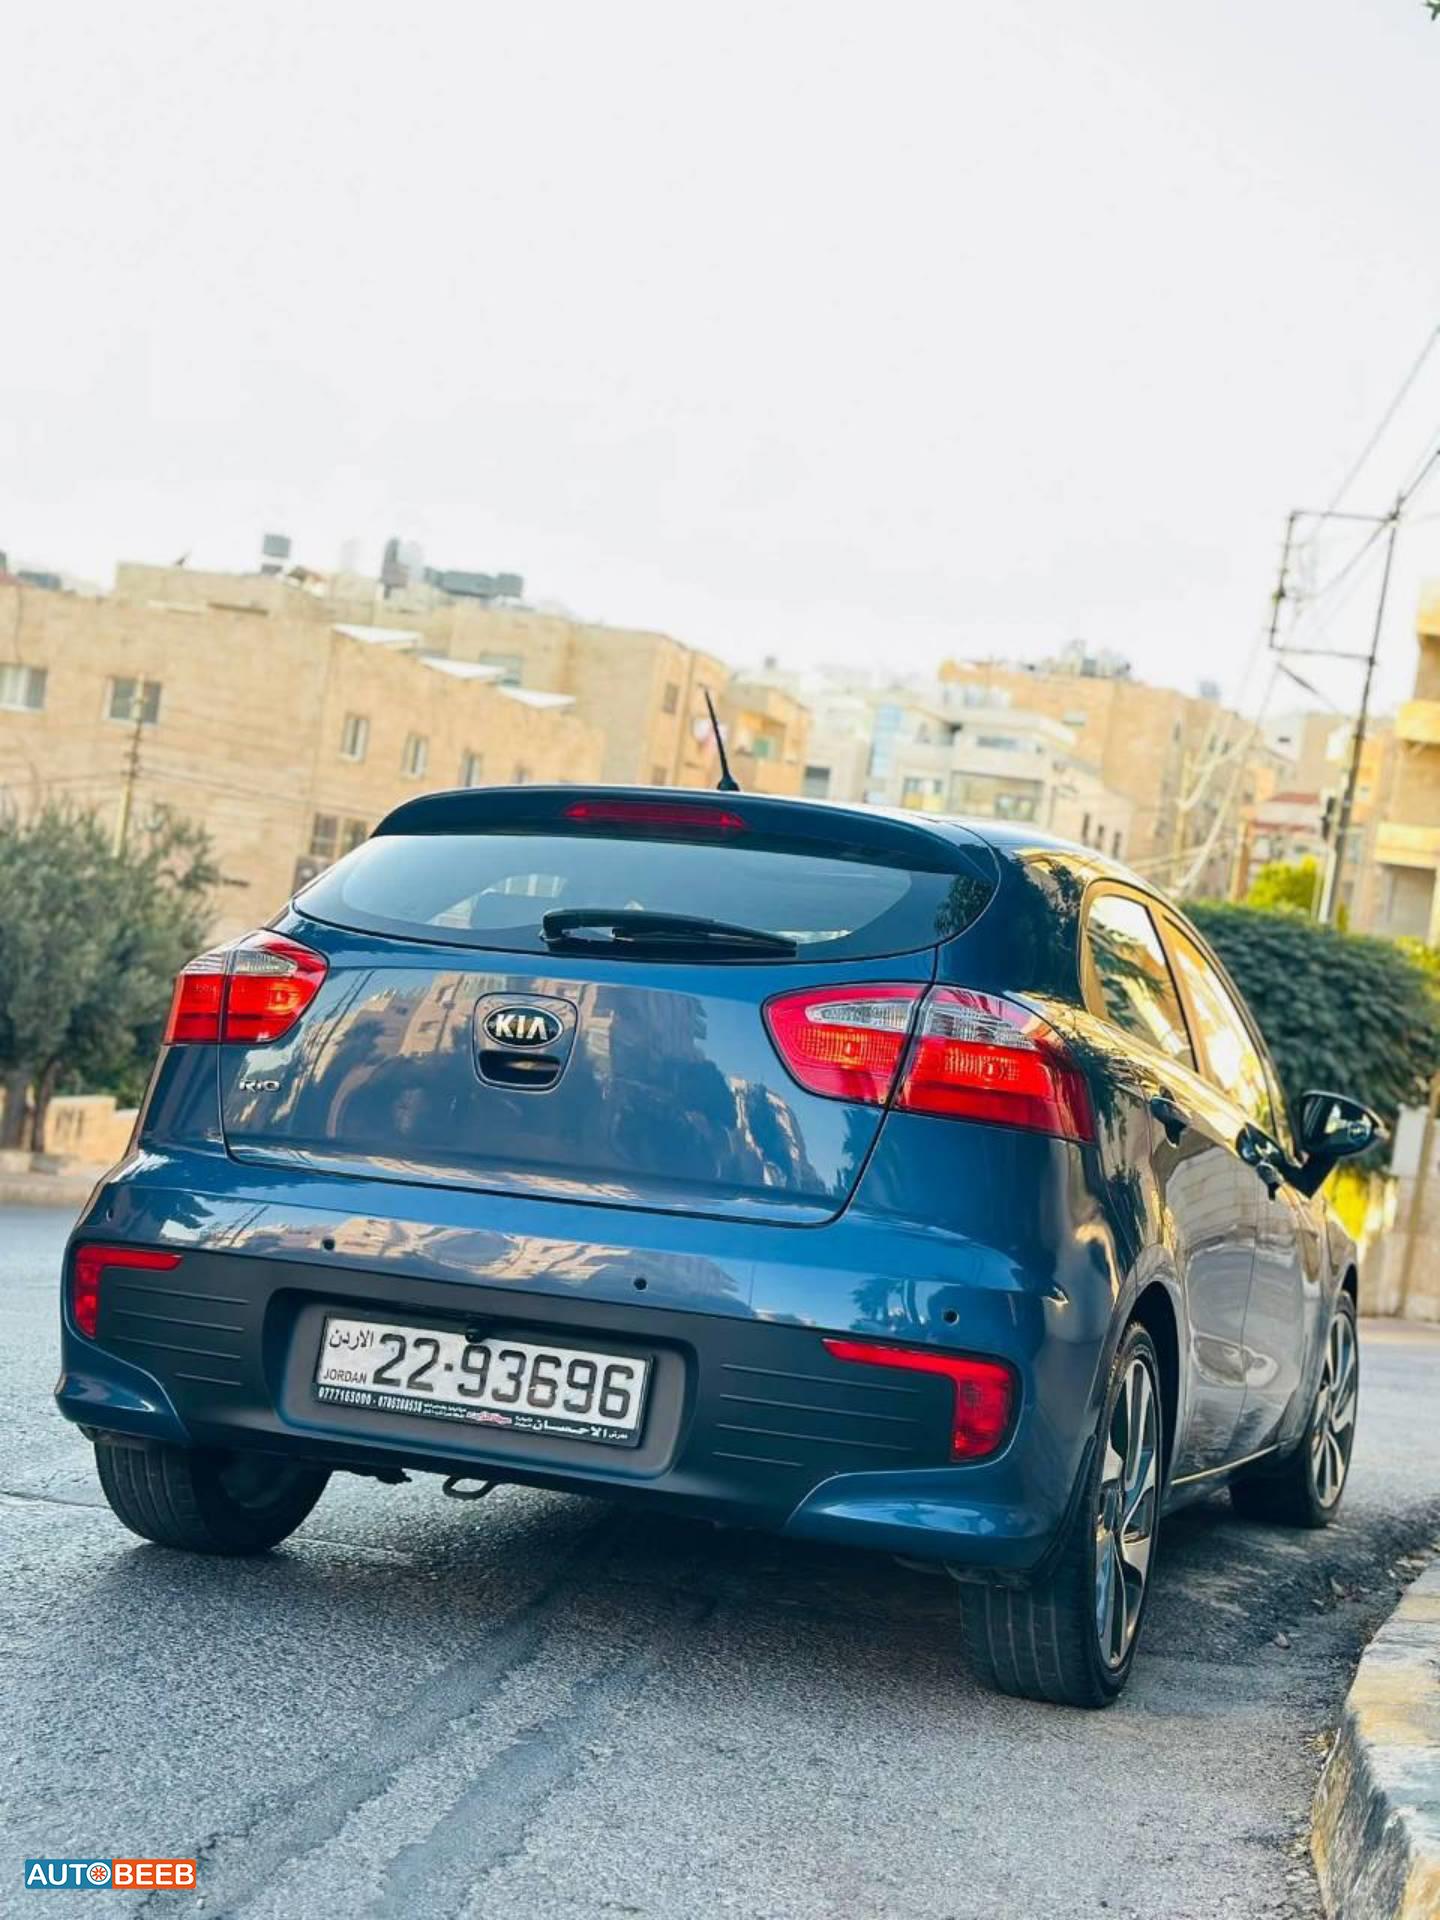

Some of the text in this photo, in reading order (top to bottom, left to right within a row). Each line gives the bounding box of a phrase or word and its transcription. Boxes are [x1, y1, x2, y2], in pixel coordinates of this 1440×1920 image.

[495, 1013, 549, 1041] KIA
[239, 1079, 281, 1092] RIO
[328, 1327, 375, 1351] الاردن
[322, 1367, 368, 1385] JORDAN
[372, 1332, 635, 1420] 22-93696
